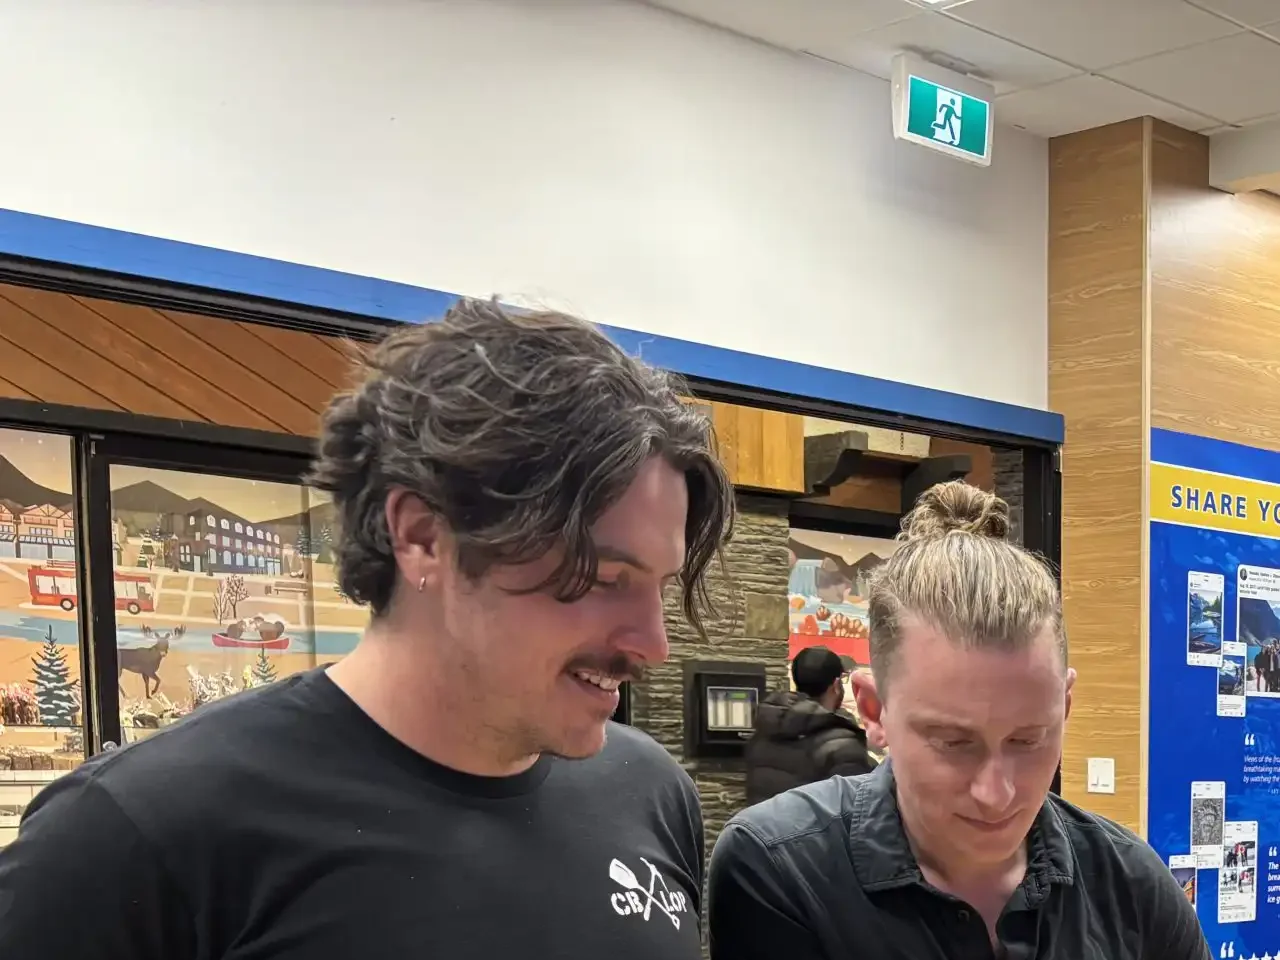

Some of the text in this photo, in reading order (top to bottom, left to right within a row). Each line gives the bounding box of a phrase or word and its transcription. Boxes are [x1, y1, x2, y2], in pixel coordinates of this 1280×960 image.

[1171, 485, 1247, 518] SHARE
[1243, 765, 1272, 774] breathtaking
[1243, 775, 1250, 784] by
[1250, 775, 1272, 784] watching
[1268, 862, 1279, 870] The
[1267, 894, 1276, 904] ice
